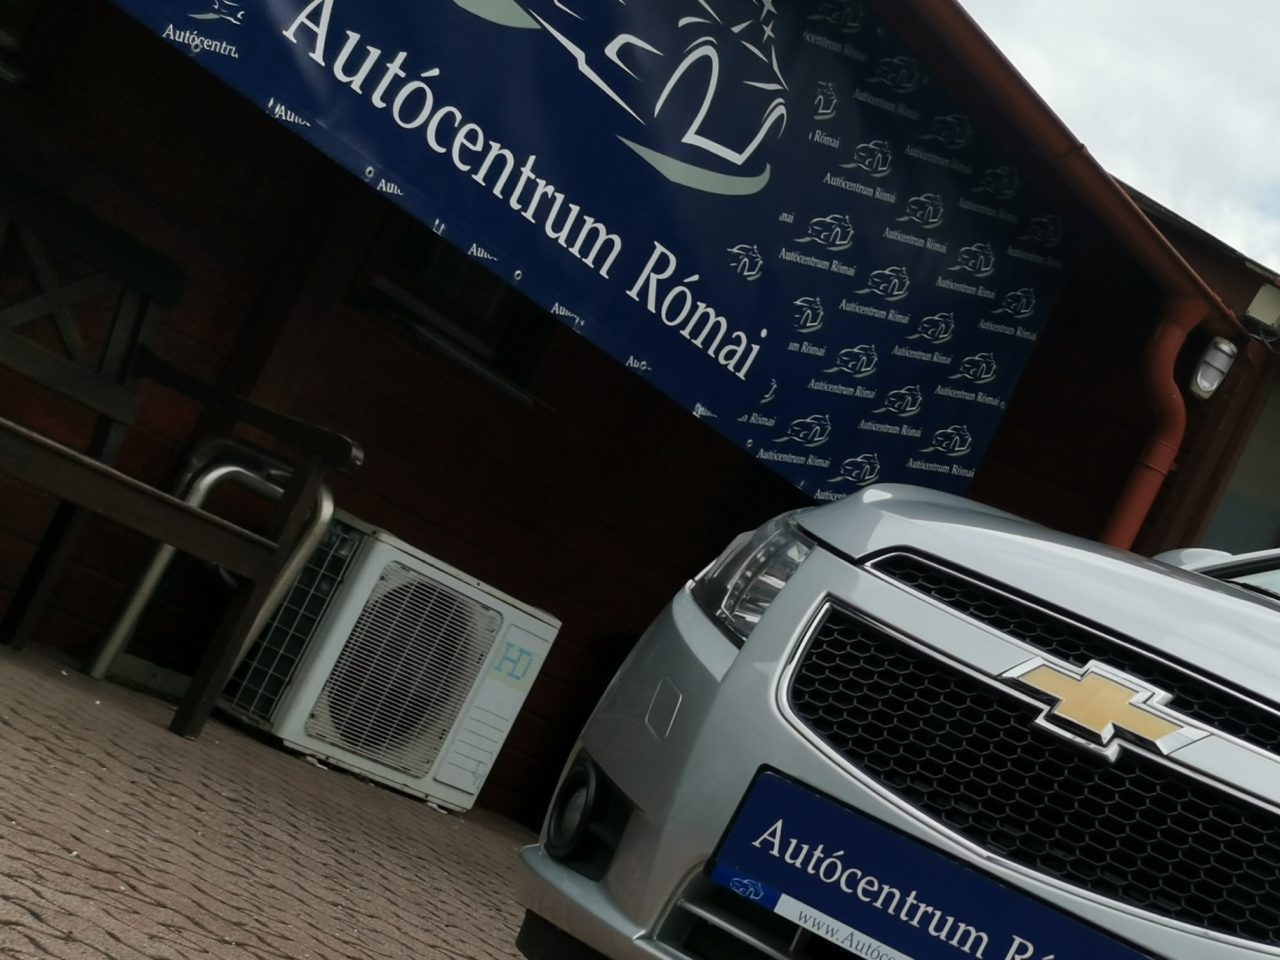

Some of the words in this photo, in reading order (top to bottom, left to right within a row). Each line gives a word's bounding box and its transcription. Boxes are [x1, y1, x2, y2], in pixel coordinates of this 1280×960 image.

[162, 23, 239, 59] Autócentru
[282, 0, 623, 280] Autócentrum
[626, 241, 769, 381] Római
[823, 172, 874, 198] Autócentrum
[751, 818, 990, 960] Autócentrum
